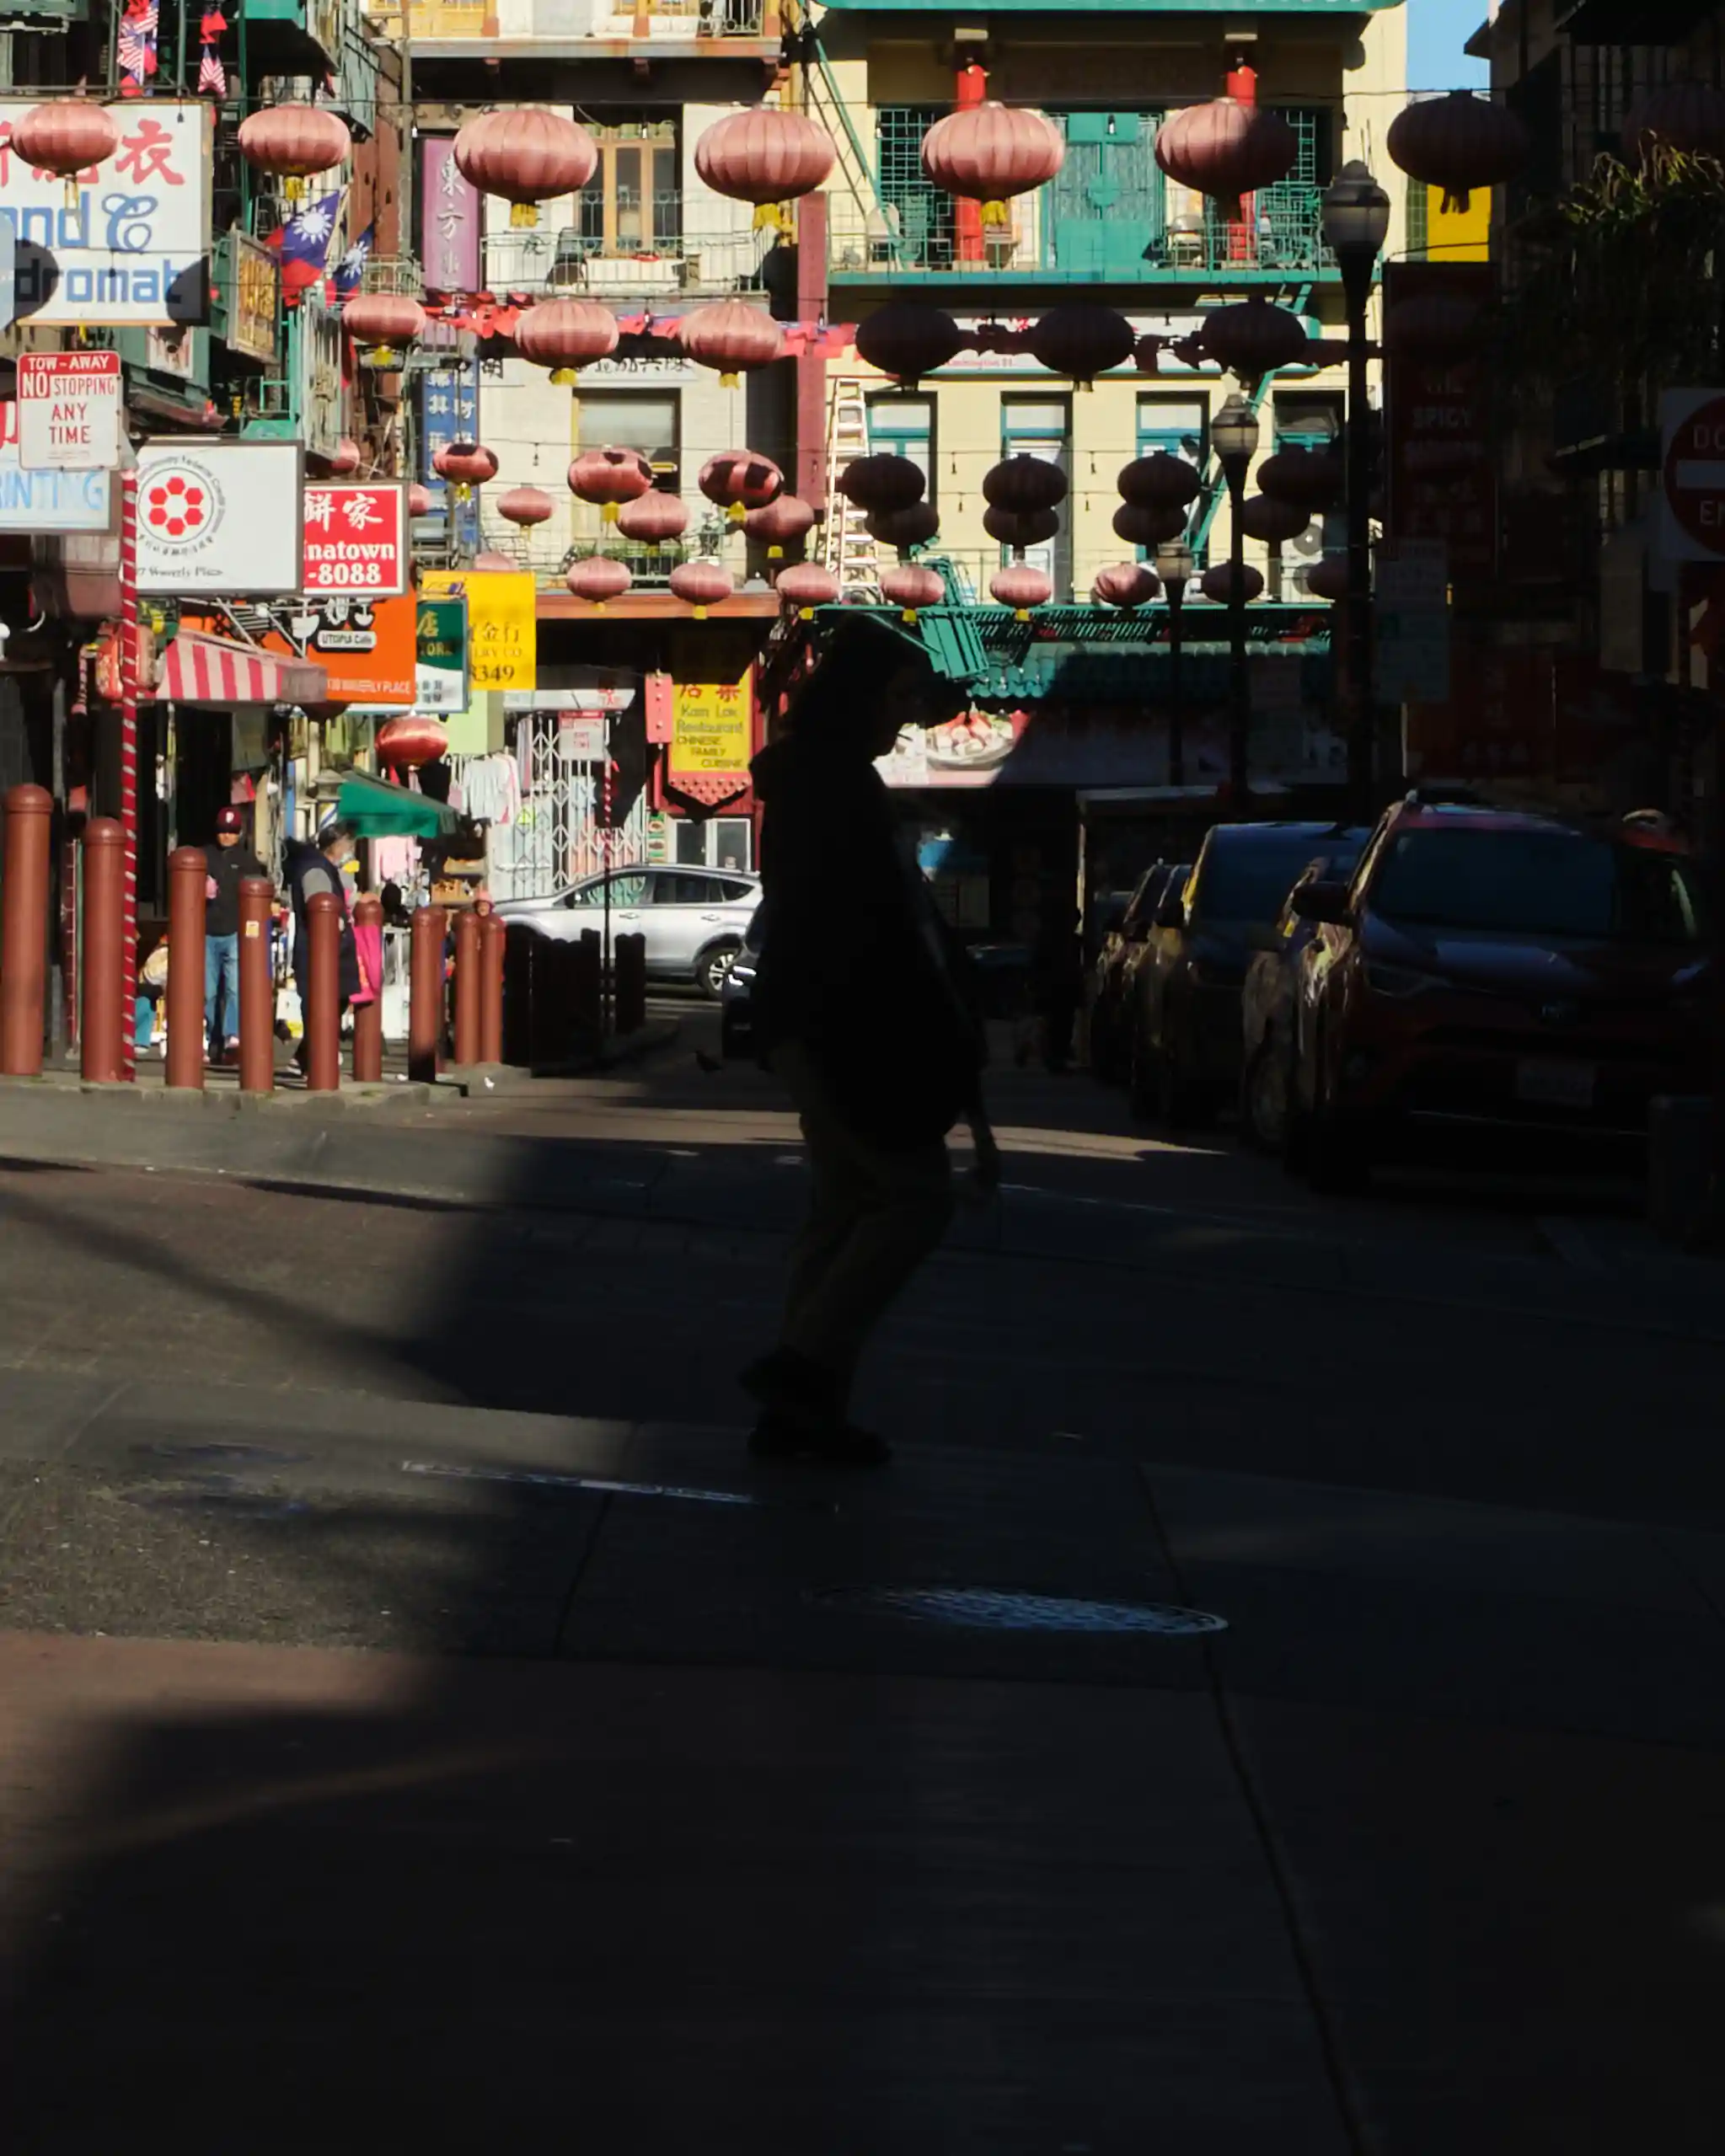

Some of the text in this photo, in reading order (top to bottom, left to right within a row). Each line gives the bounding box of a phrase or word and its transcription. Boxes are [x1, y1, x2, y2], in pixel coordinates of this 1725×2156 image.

[22, 372, 115, 398] NO STOPPING
[51, 403, 88, 420] ANY
[48, 425, 91, 443] TIME
[0, 470, 103, 510] INTING
[303, 540, 395, 560] natown
[308, 563, 382, 585] -8088
